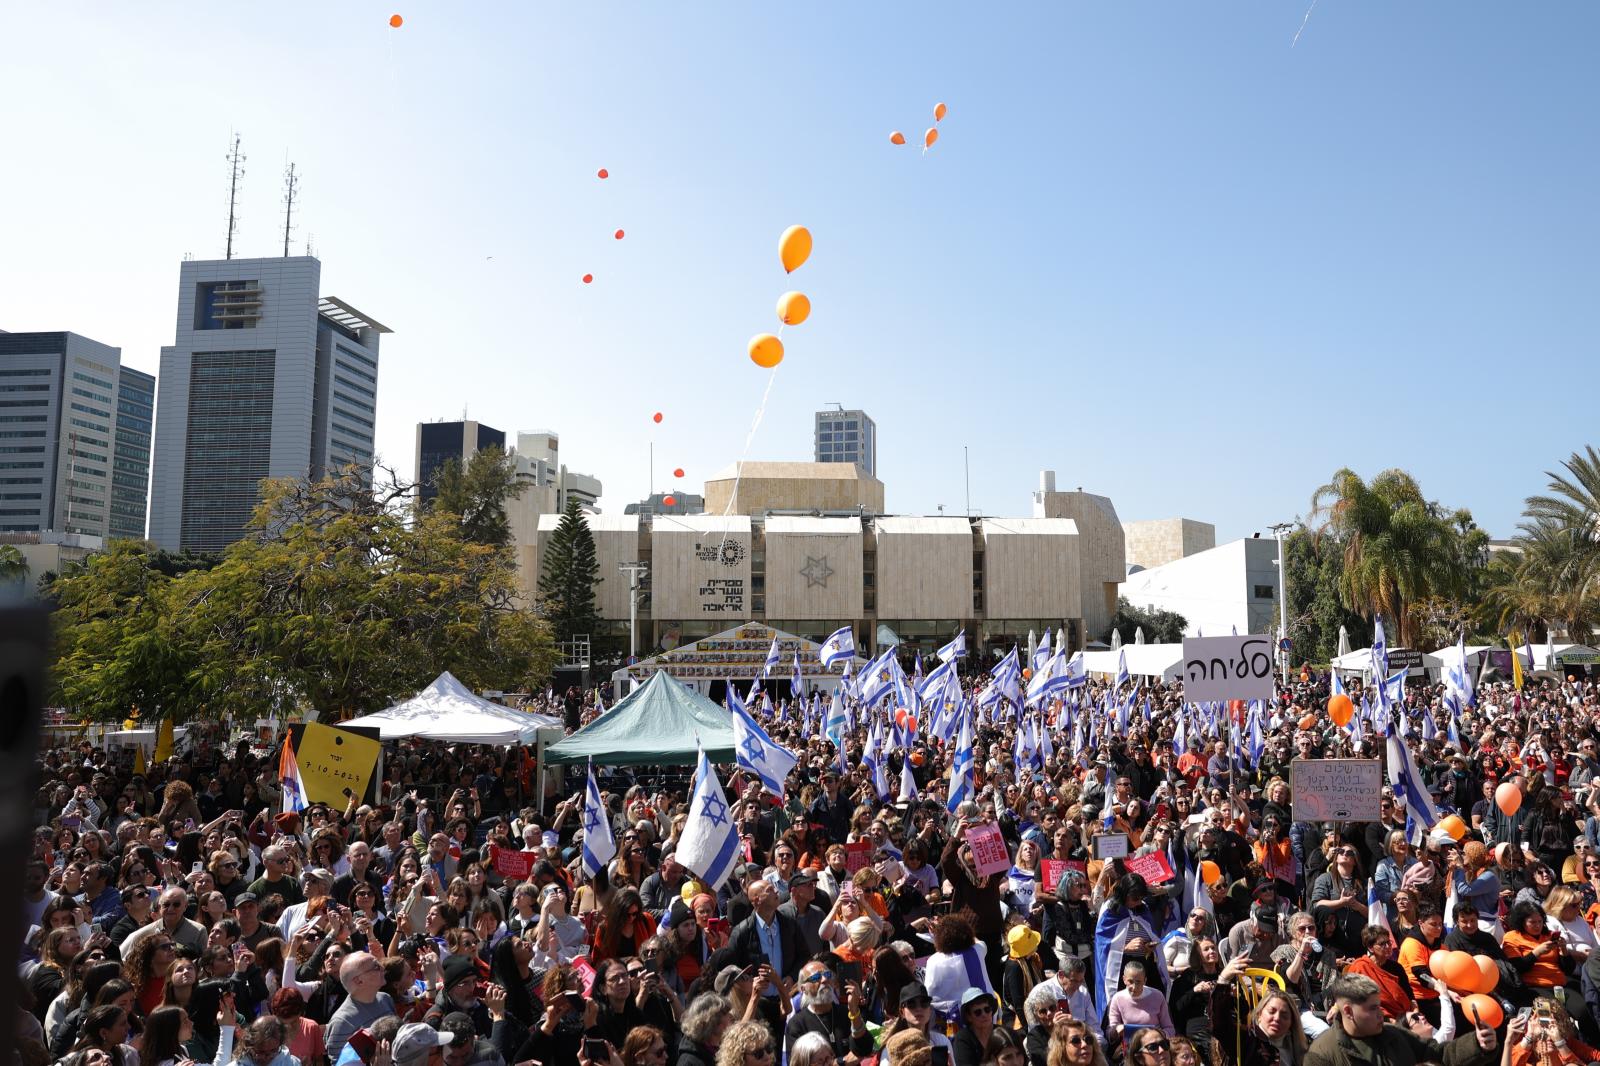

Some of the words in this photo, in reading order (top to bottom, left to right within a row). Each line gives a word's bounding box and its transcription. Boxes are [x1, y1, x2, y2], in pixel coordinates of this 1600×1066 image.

[1187, 640, 1270, 682] סליחה
[306, 761, 359, 782] 7.10.2023
[1325, 762, 1353, 774] שלום
[1354, 764, 1376, 774] היה
[1308, 775, 1325, 786] קטן
[1331, 775, 1365, 787] בטמן
